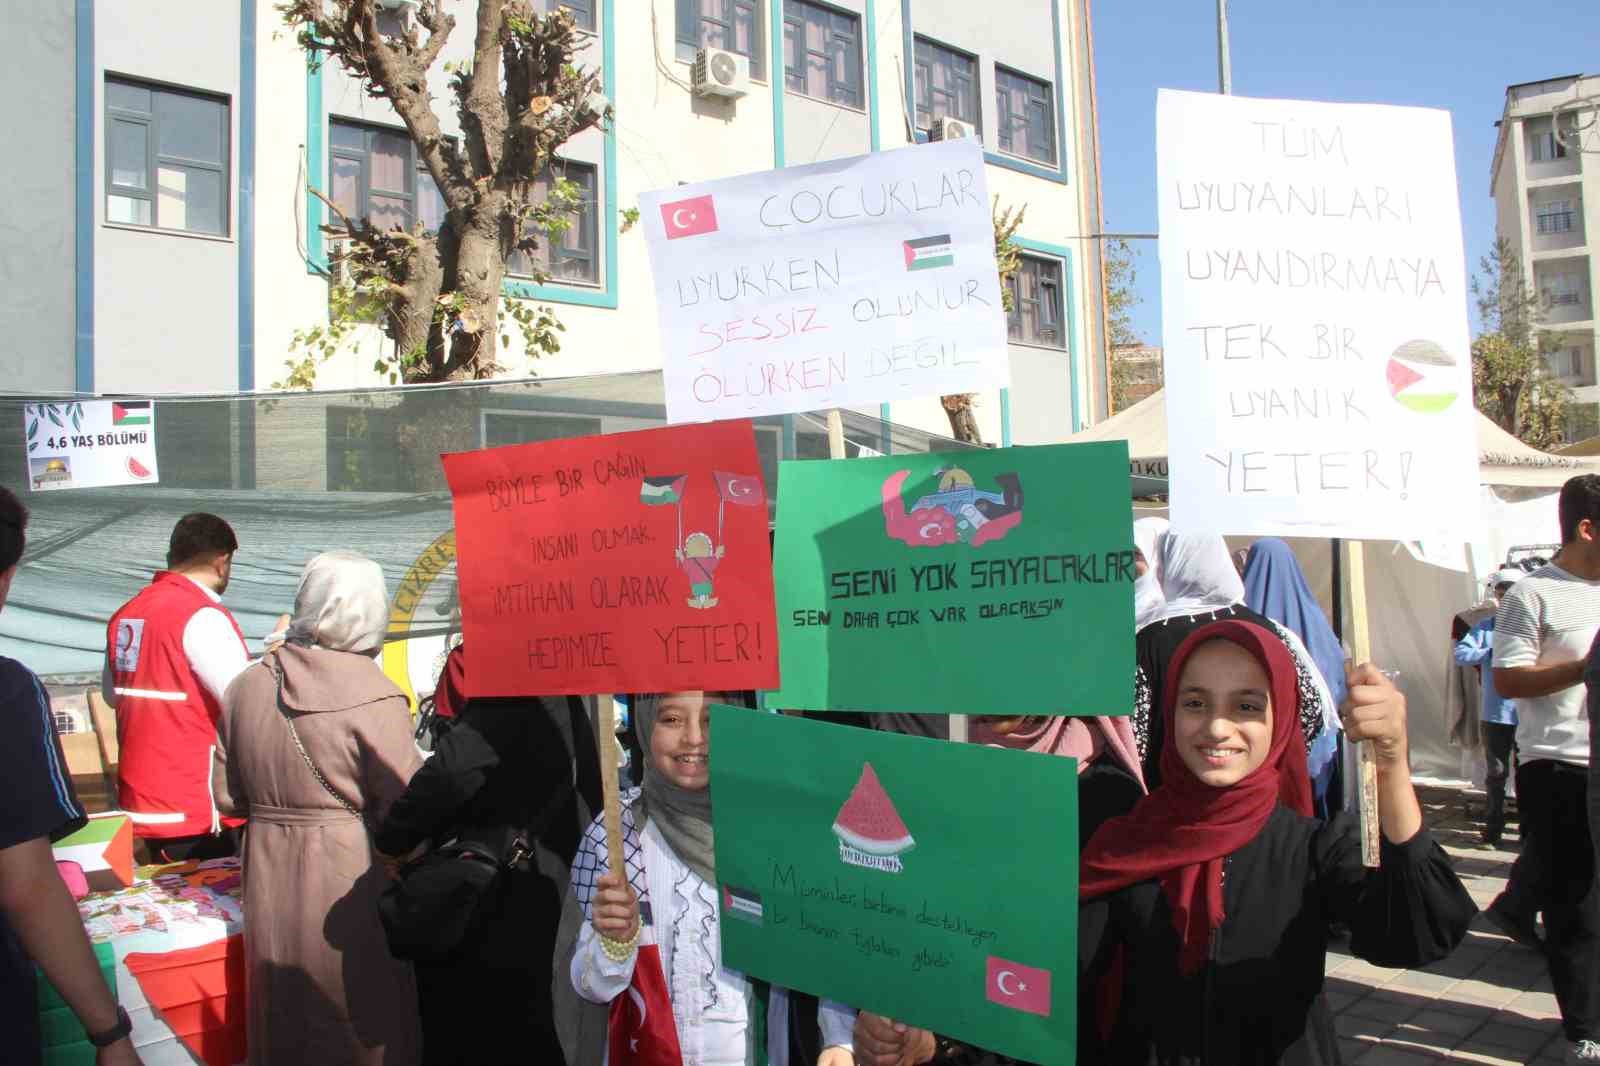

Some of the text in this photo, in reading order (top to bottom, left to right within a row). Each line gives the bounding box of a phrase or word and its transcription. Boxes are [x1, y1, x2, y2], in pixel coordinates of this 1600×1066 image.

[1249, 117, 1350, 167] TÜM
[759, 169, 981, 231] ÇOCUKLAR
[1176, 180, 1413, 223] UYUYANLARI
[674, 248, 841, 308] UYURKEN
[1186, 249, 1445, 297] UYANDIRMAYA
[851, 279, 992, 322] OLUNUR
[1186, 323, 1288, 361] TEK
[1230, 388, 1370, 422] UYANIK
[71, 435, 94, 450] YAŞ
[98, 431, 148, 446] BÖLÜMÜ
[485, 474, 546, 512] BÖYLE
[1205, 450, 1413, 500] YETER!
[590, 575, 672, 609] OLARAK
[910, 562, 958, 593] YOK
[970, 550, 1136, 589] SAYACAKLAR
[792, 598, 1065, 629] SEN DAHA ÇOK VAR OLACAKSIN
[654, 622, 763, 665] YETER!
